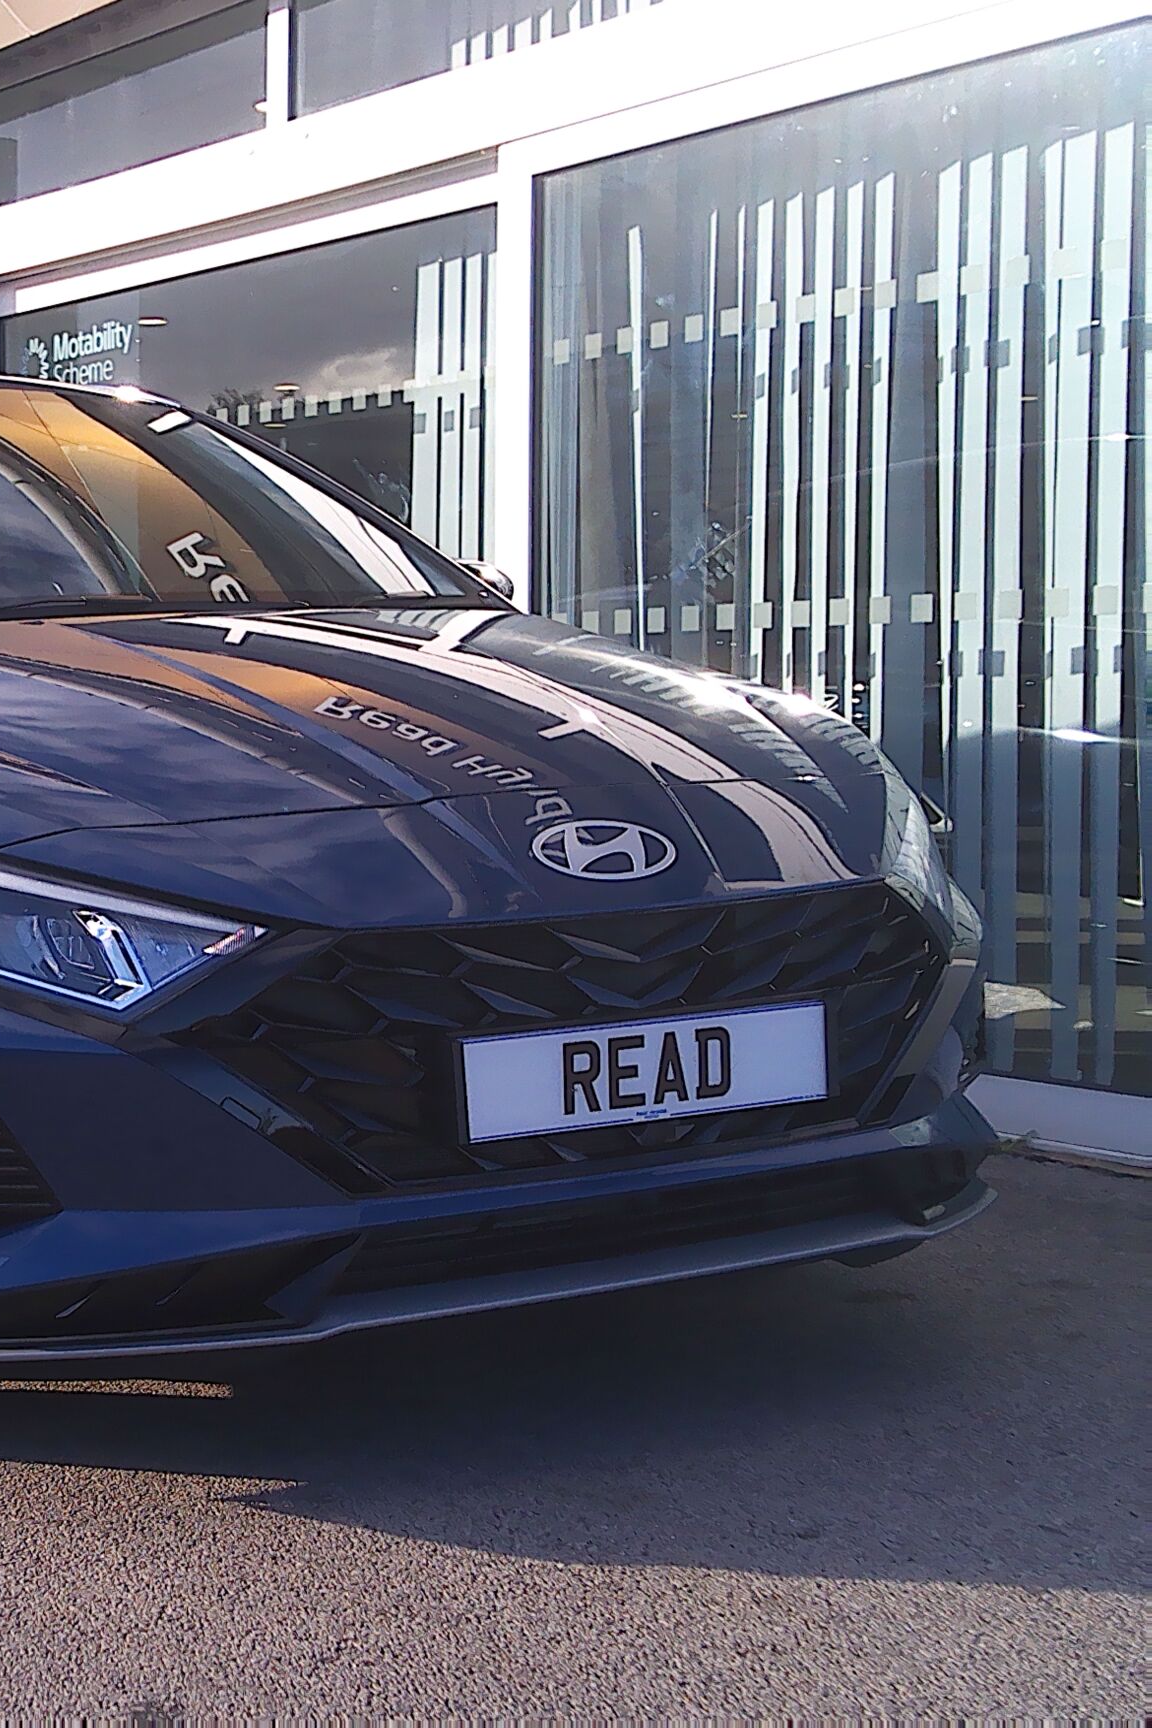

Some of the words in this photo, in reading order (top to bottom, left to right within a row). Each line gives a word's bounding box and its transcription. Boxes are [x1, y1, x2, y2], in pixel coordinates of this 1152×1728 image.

[53, 320, 133, 362] Motability
[53, 359, 114, 385] Scheme
[562, 1026, 732, 1115] READ
